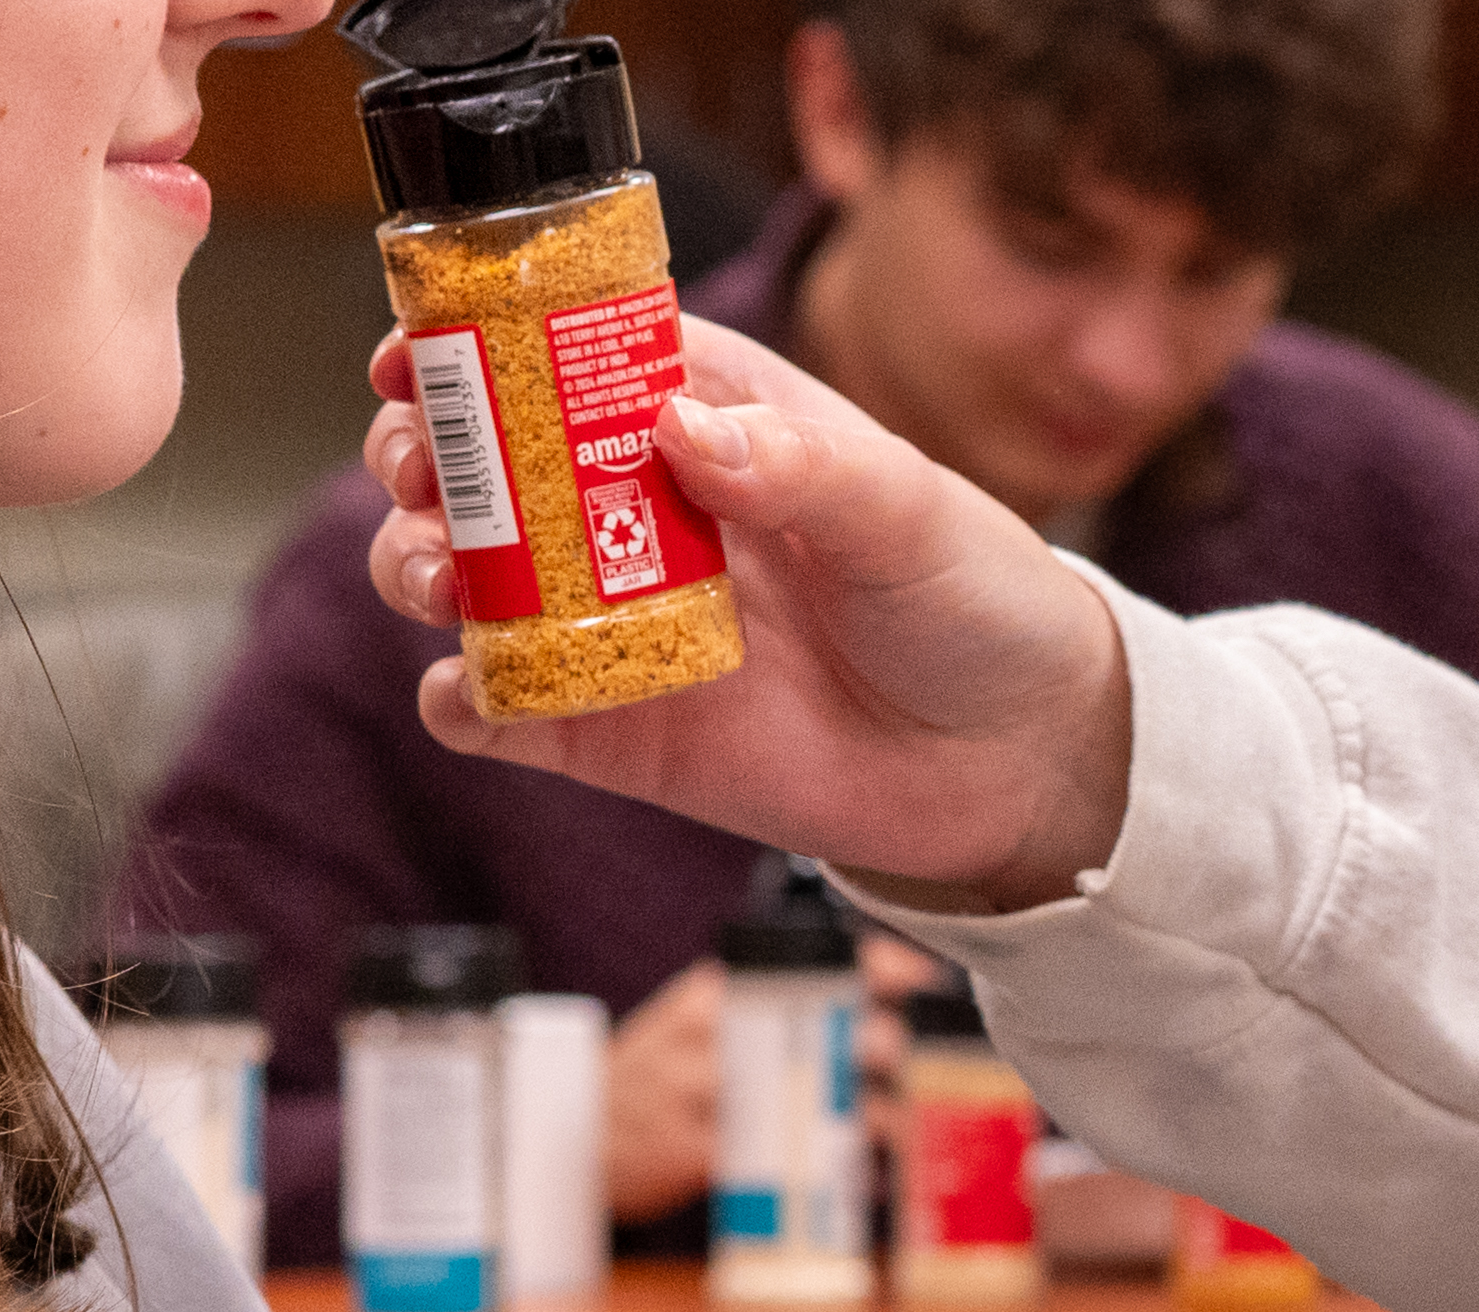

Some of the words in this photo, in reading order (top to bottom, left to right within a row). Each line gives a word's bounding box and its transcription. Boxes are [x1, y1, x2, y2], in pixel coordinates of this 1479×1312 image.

[550, 308, 605, 330] DISTRIBUTED
[570, 327, 597, 342] TERRY
[596, 320, 624, 336] AVENUE
[556, 346, 582, 362] STORE
[583, 344, 594, 356] IN
[593, 342, 602, 354] A
[621, 333, 636, 347] DRY
[559, 359, 596, 376] PRODUCT
[596, 356, 608, 370] OF
[607, 352, 629, 366] INDIA
[566, 396, 581, 408] ALL
[582, 388, 612, 405] RIGHTS
[569, 406, 603, 424] CONTACT
[604, 403, 617, 416] US
[577, 427, 660, 465] amaz
[605, 558, 651, 579] PLASTIC
[623, 576, 640, 586] JAR
